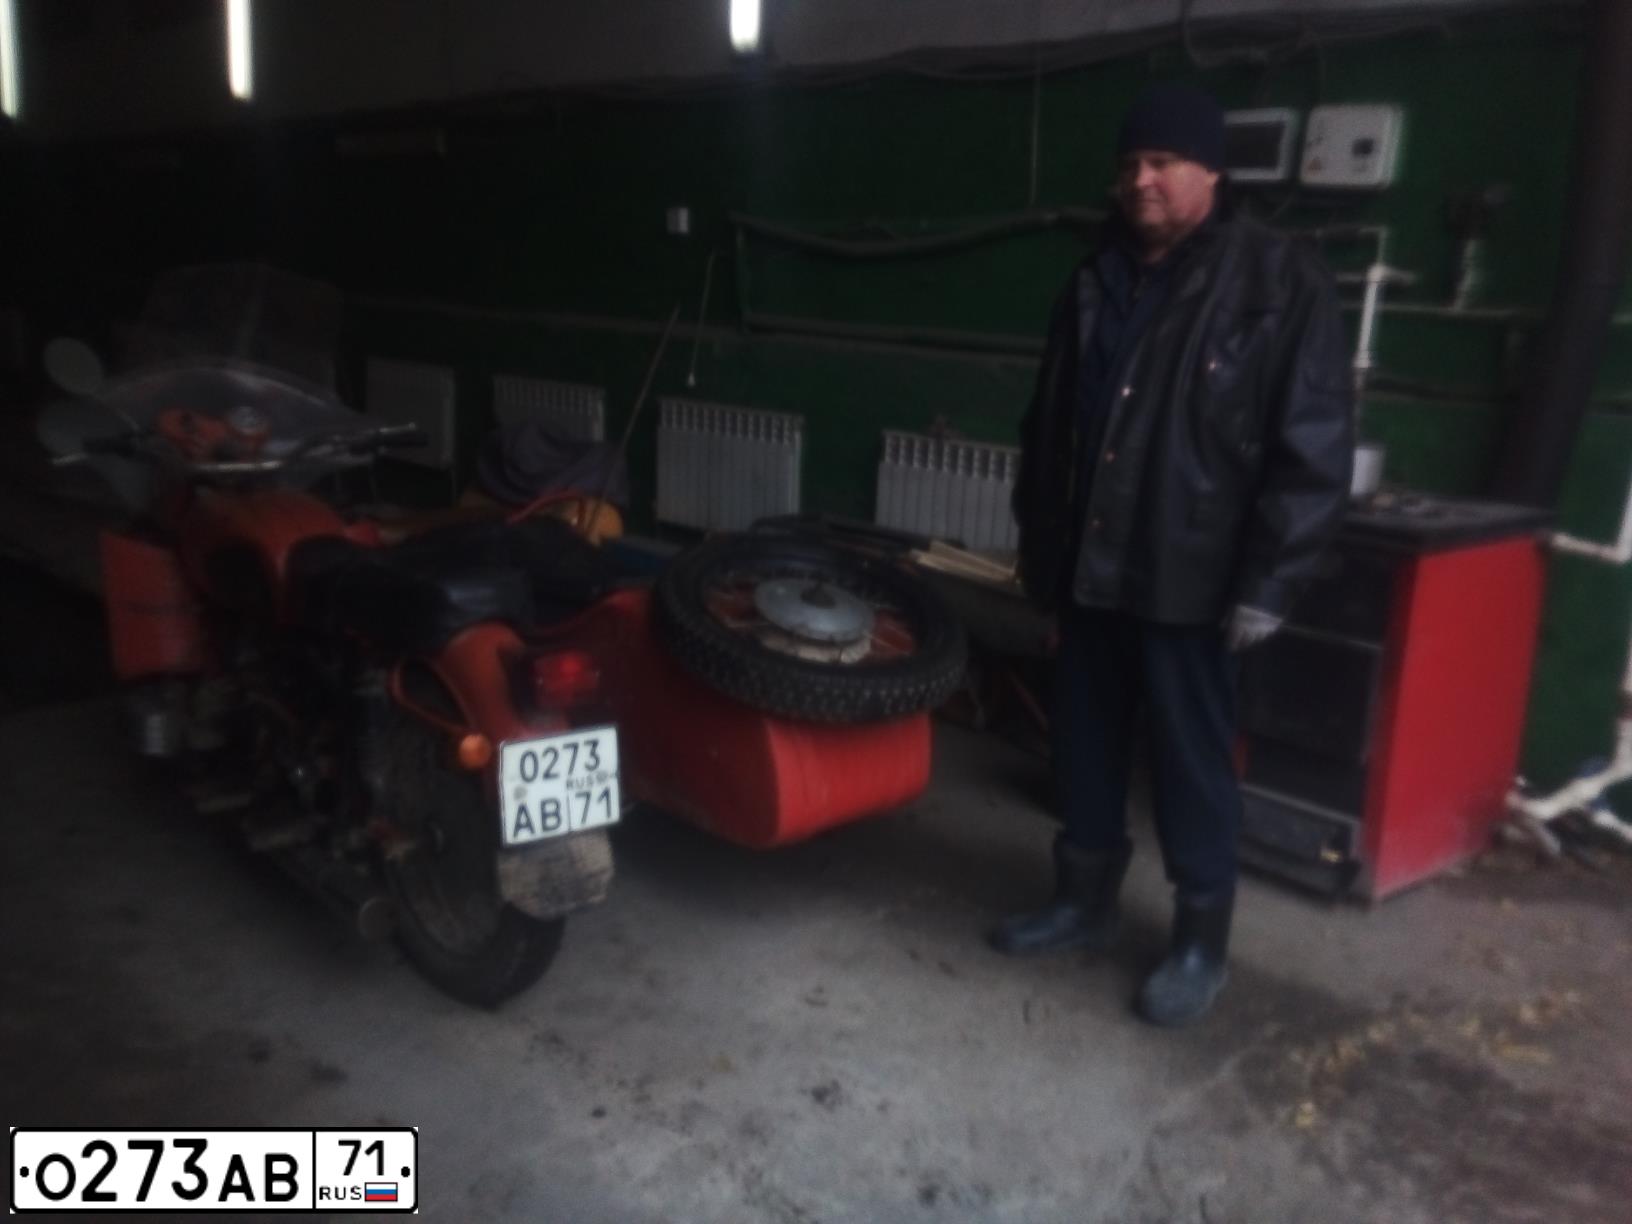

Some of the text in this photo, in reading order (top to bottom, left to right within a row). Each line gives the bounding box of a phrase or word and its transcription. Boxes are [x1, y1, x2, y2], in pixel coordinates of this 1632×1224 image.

[520, 739, 600, 783] 0273
[513, 786, 611, 838] AB 71
